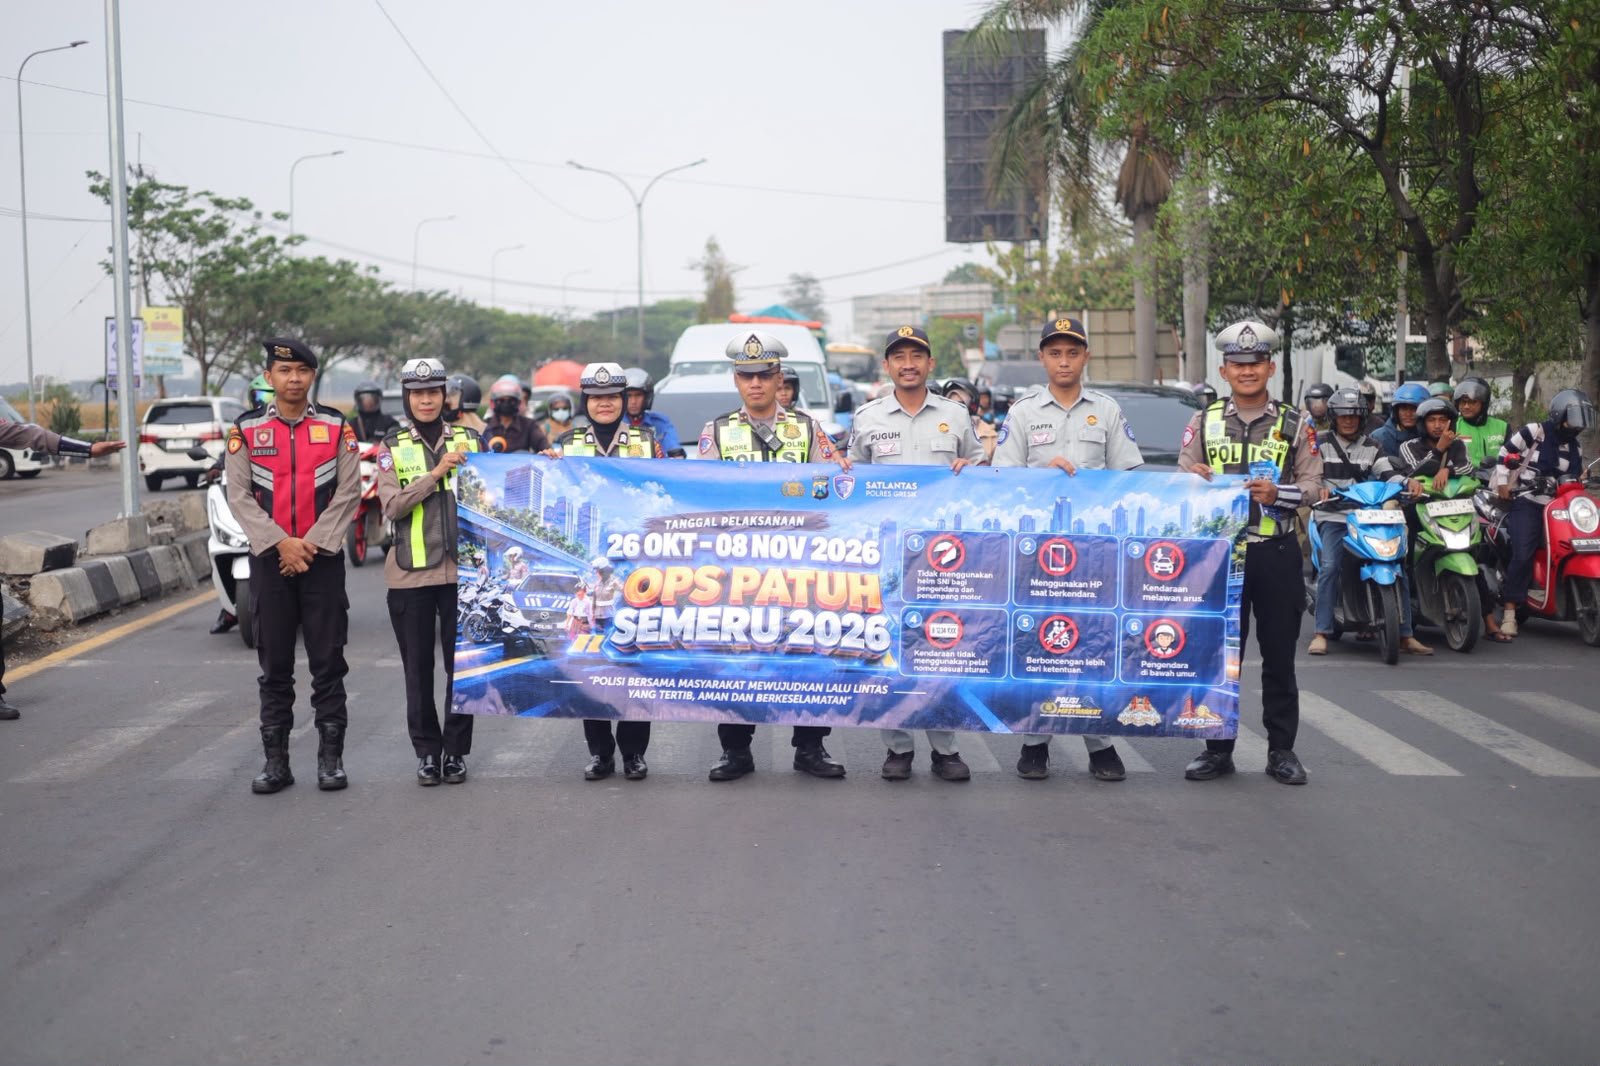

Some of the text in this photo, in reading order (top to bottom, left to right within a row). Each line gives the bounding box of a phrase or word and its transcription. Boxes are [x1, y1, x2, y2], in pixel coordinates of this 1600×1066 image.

[1030, 423, 1053, 431] DAFFA
[870, 432, 901, 442] PUGUH
[725, 444, 748, 452] ANDRE
[1263, 440, 1288, 452] POLRI
[398, 465, 421, 473] NAYA
[865, 481, 917, 490] SATLANTAS
[865, 489, 917, 498] POLRES GRESIK
[664, 515, 805, 530] TANGGAL PELAKSANAAN
[606, 533, 641, 559] 26
[643, 532, 698, 558] OKT
[715, 533, 750, 558] 08
[751, 534, 807, 561] NOV
[810, 537, 881, 565] 2026
[939, 571, 994, 579] menggunakan
[951, 579, 968, 587] bagi
[1030, 579, 1103, 589] Menggunakan HP
[623, 565, 884, 614] OPS PATUH
[916, 586, 960, 594] pengendara
[1142, 583, 1188, 594] Kendaraan
[916, 593, 984, 602] penumpang motor.
[1030, 589, 1098, 598] saat berkendara.
[1142, 593, 1205, 603] melawan arus.
[610, 606, 892, 655] SEMERU 2026
[956, 650, 976, 658] tidak
[913, 658, 989, 667] menggunakan pelat
[1026, 656, 1106, 667] Berboncengan lebih
[1141, 660, 1189, 670] Pengendara
[939, 665, 963, 673] sesuai
[1025, 664, 1084, 674] dari ketentuan.
[1149, 669, 1175, 677] bawah
[627, 676, 675, 688] BERSAMA
[677, 678, 746, 690] MASYARAKAT
[747, 680, 824, 693] MEWUJUDKAN
[825, 683, 852, 694] LALU
[853, 684, 889, 695] LINTAS
[628, 689, 656, 699] YANG
[659, 690, 695, 702] TERTIB,
[697, 691, 729, 702] AMAN
[731, 692, 752, 703] DAN
[1055, 696, 1080, 704] POLISI
